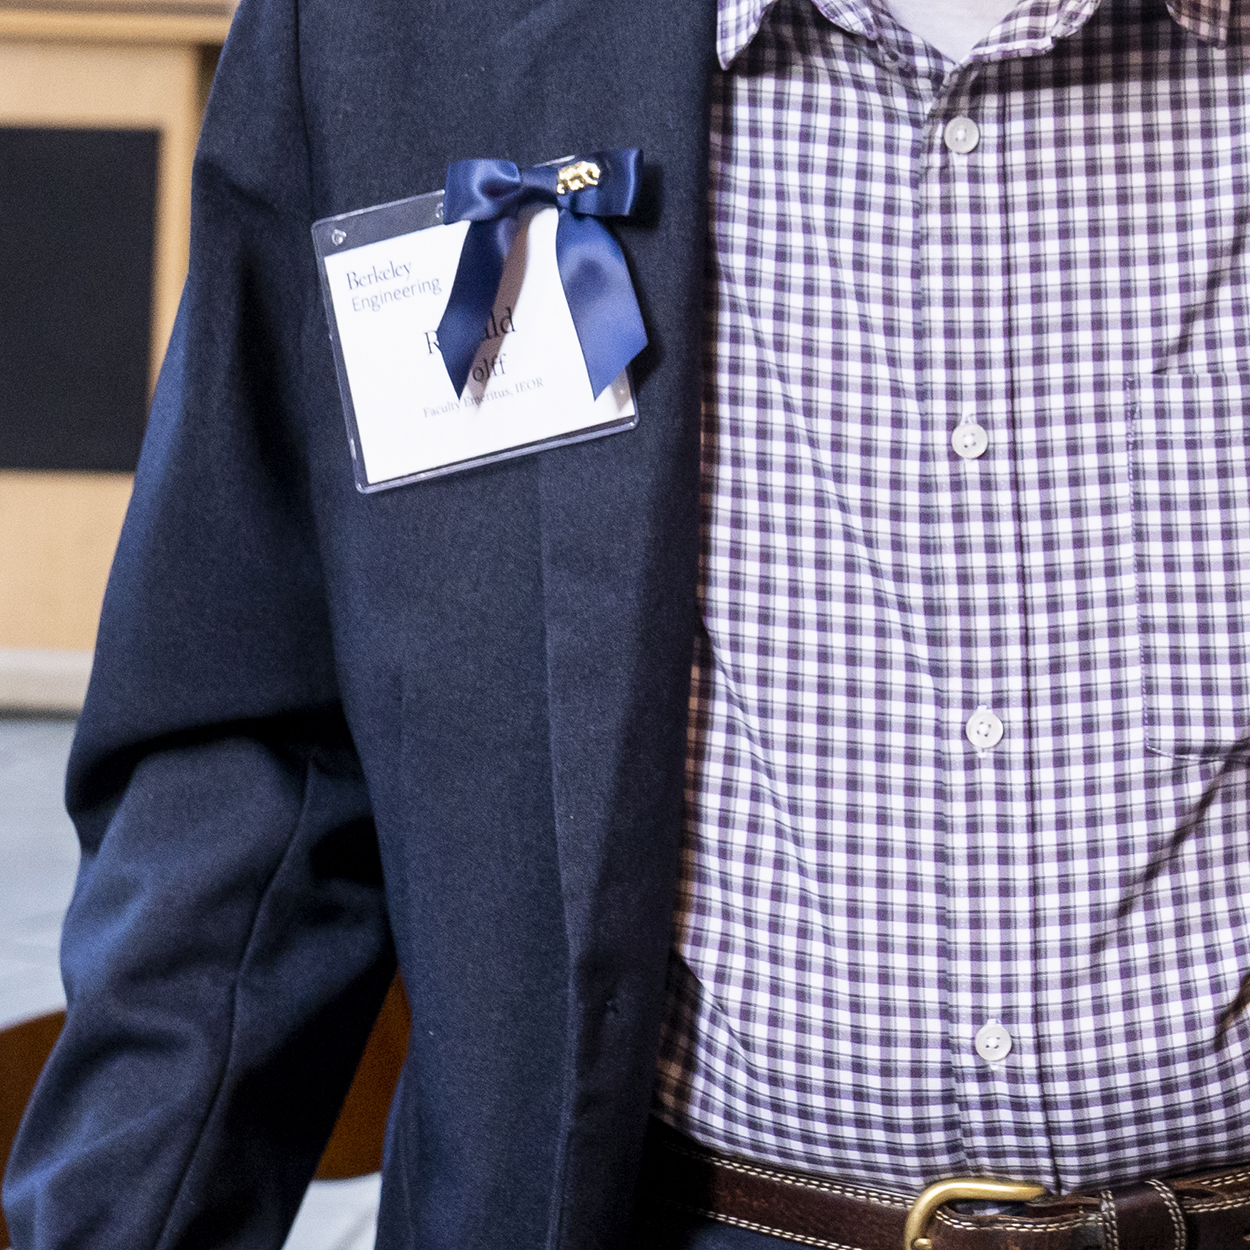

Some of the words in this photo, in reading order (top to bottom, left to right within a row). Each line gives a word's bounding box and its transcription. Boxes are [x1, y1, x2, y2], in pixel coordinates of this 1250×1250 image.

[346, 260, 412, 290] Berkeley
[352, 278, 442, 312] Engineering
[424, 306, 517, 354] Rld
[472, 353, 507, 383] olff
[423, 400, 460, 418] Faculty
[515, 377, 544, 394] IEOR
